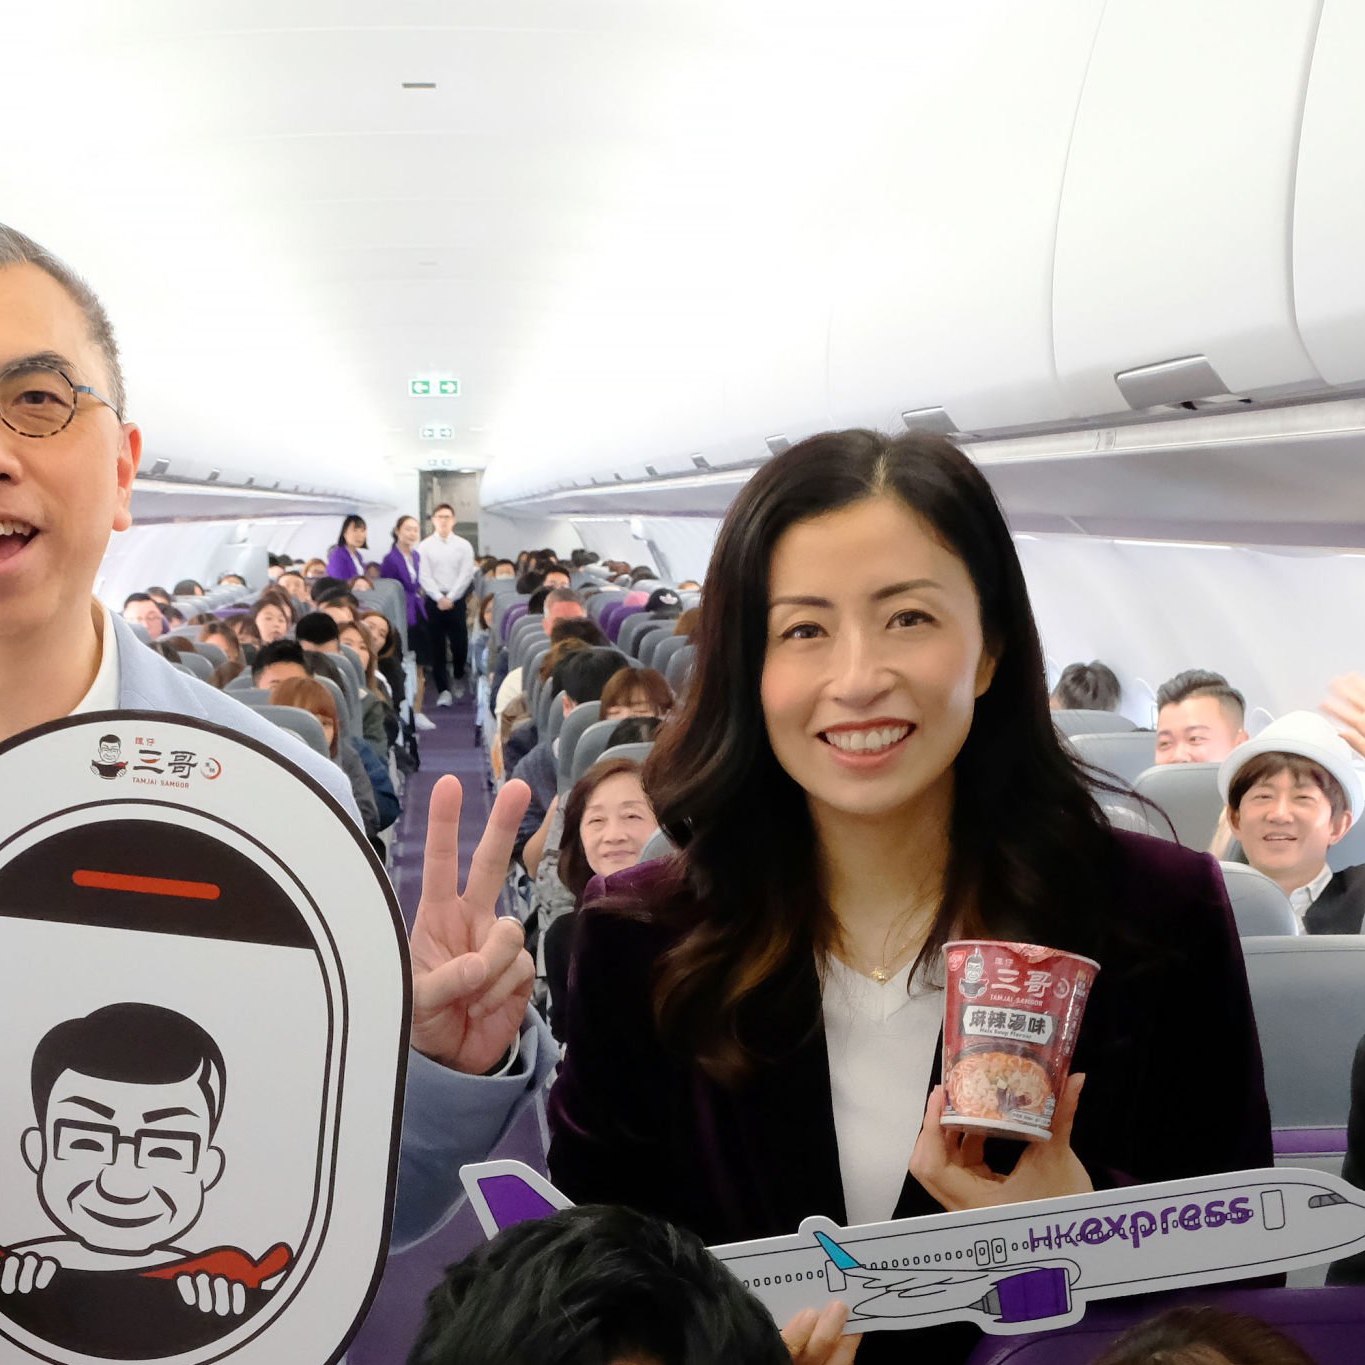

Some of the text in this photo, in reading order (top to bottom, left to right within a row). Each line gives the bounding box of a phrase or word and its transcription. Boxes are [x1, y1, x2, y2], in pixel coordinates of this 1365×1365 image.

[133, 749, 198, 779] 三哥
[132, 777, 157, 785] TAMJAI
[991, 968, 1053, 998] 三哥
[969, 1010, 1046, 1035] 麻辣湯味
[1029, 1197, 1250, 1252] HKexpress
